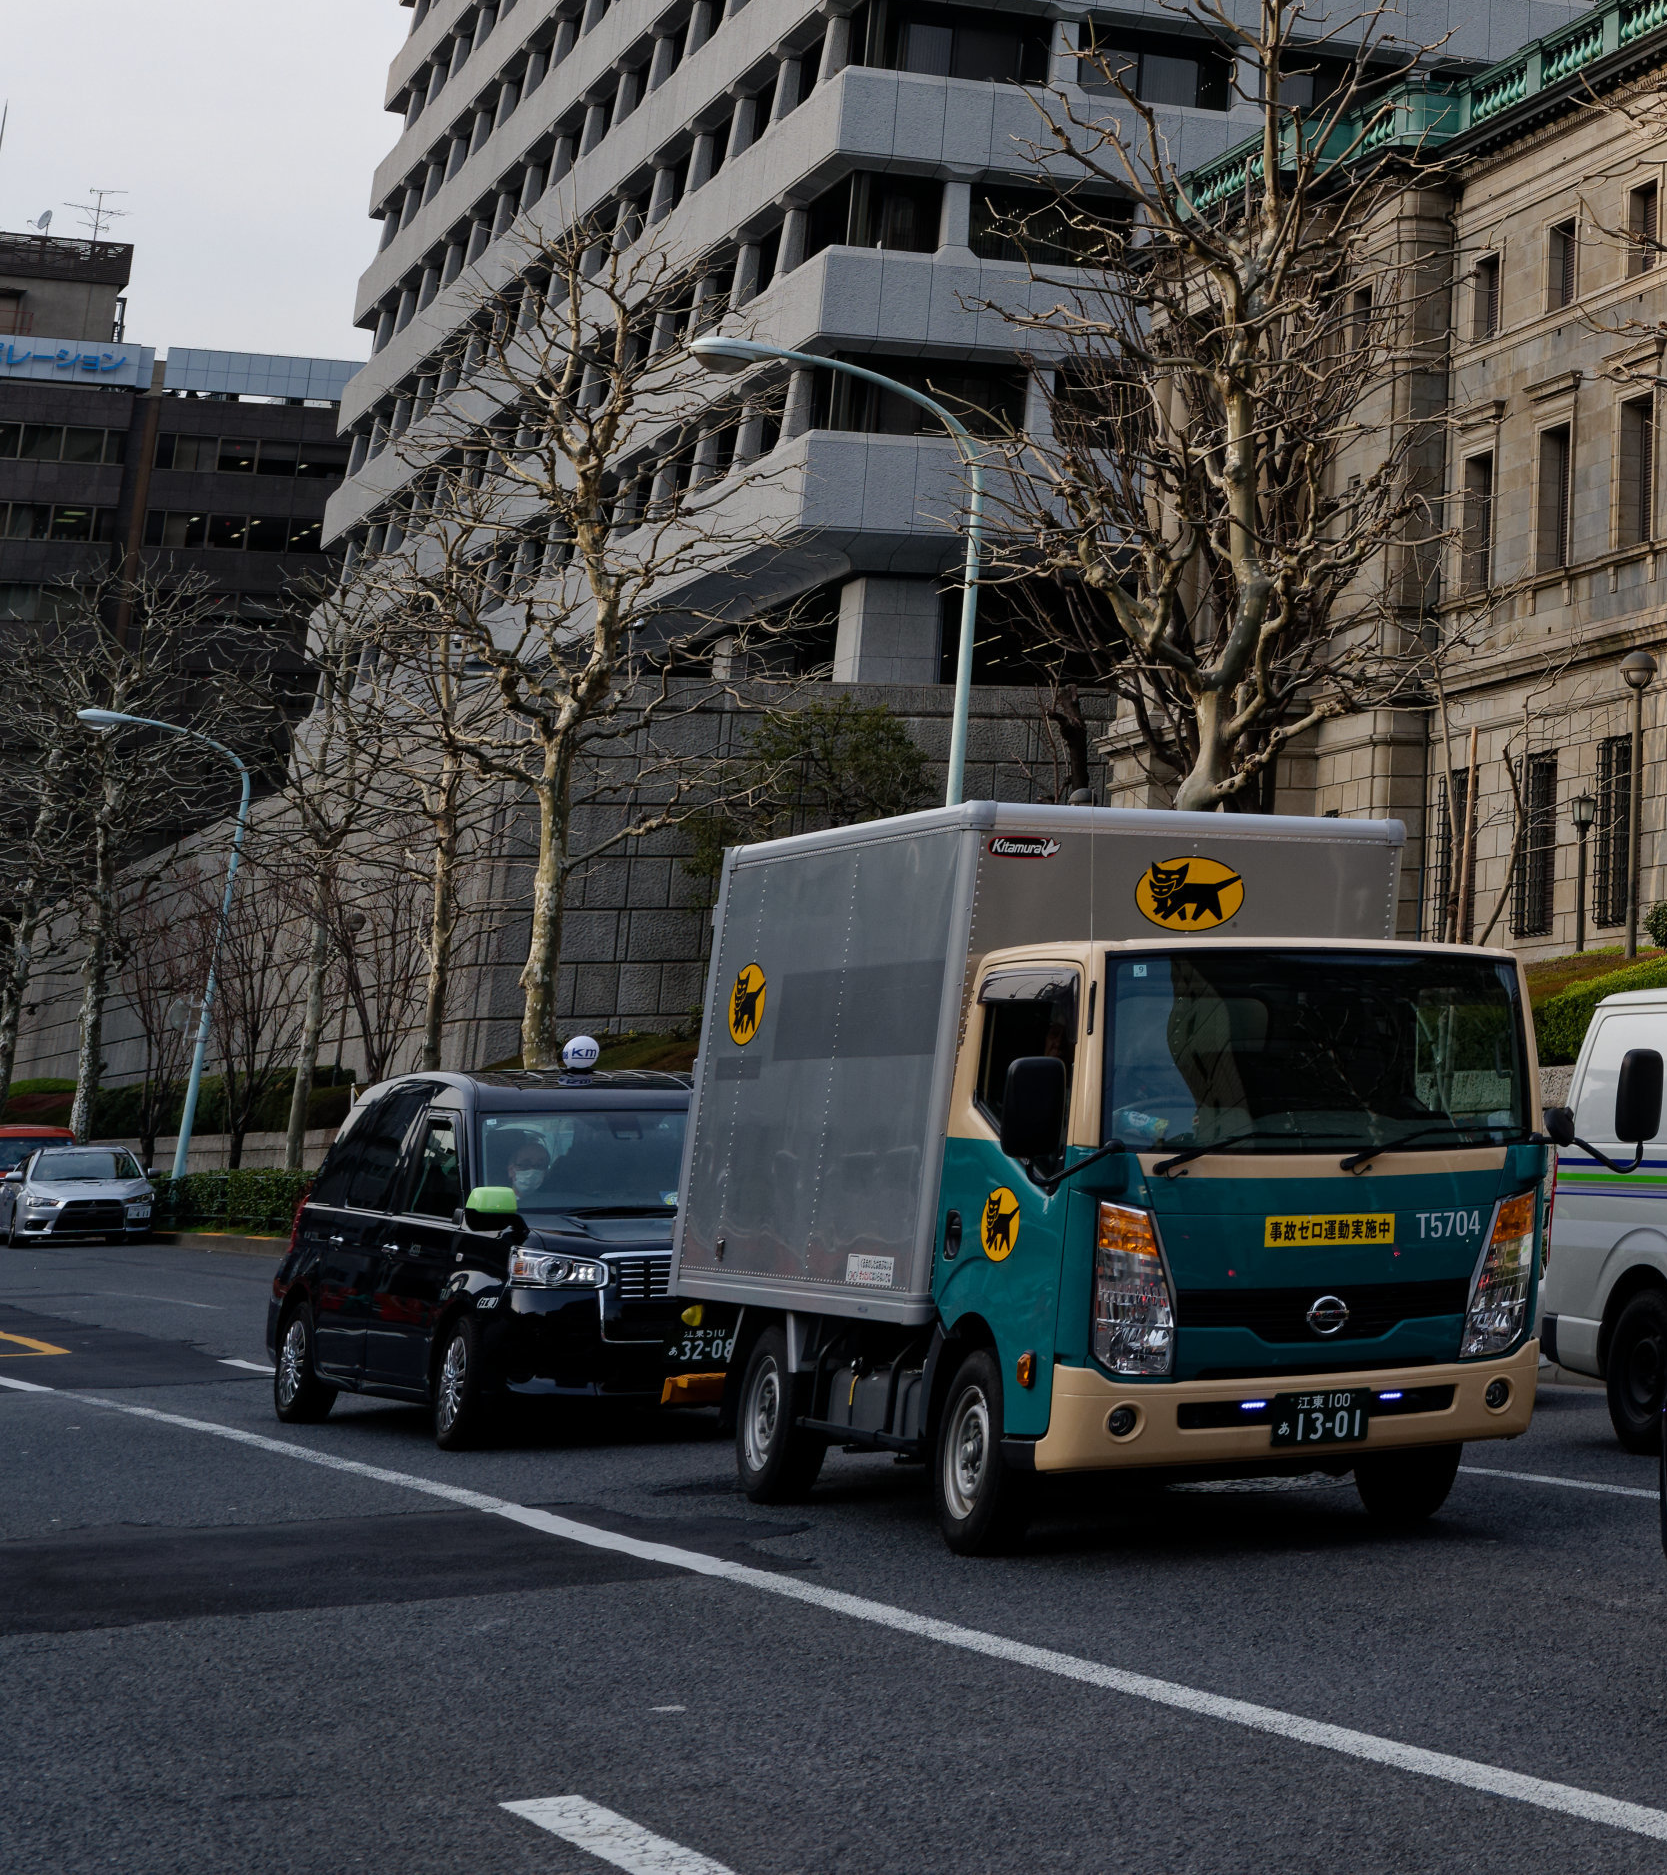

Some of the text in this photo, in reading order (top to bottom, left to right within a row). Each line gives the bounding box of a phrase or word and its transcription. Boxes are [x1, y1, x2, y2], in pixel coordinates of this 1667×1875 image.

[0, 343, 126, 371] レーション
[992, 838, 1042, 854] Kitamura
[1270, 1210, 1480, 1242] 事故ゼロ運動実施中 T5704
[1278, 1409, 1361, 1441] あ 13-01
